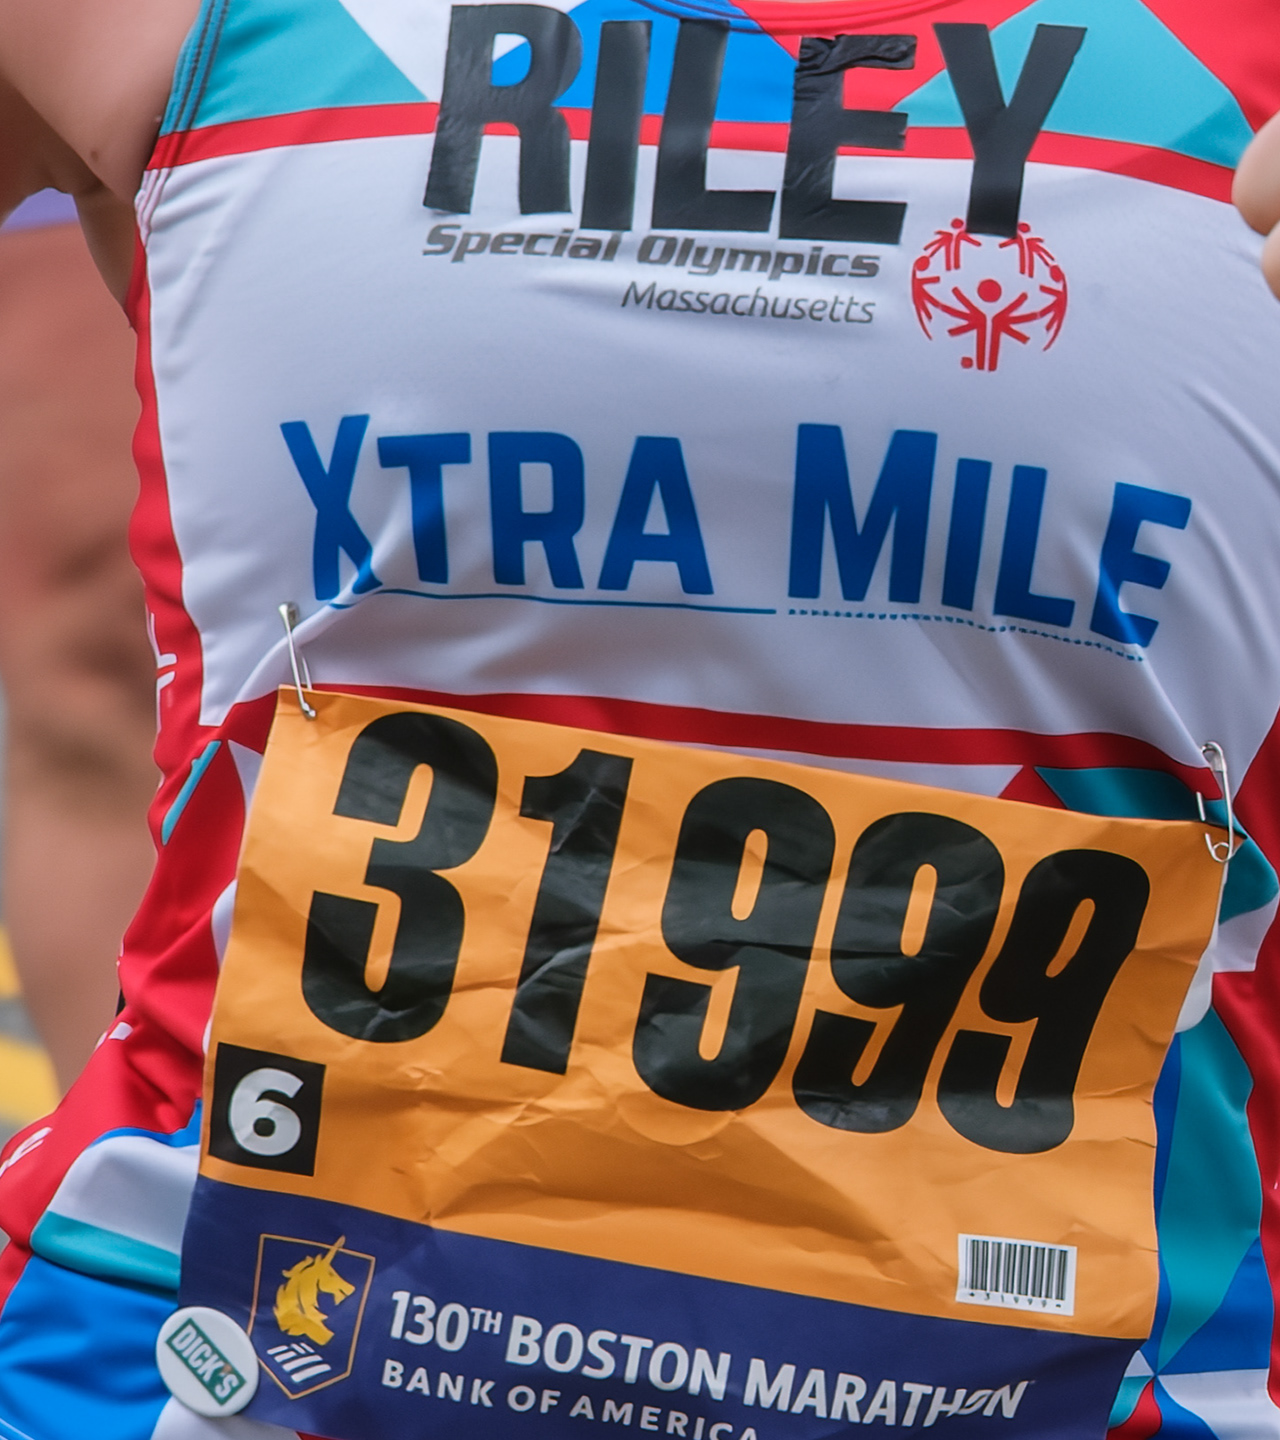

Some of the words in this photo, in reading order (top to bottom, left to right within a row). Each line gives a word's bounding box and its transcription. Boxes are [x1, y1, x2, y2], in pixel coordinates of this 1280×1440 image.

[423, 2, 1088, 245] RILEY
[422, 223, 623, 263] Special
[636, 233, 881, 281] Olympics
[621, 281, 876, 324] Massachusetts
[279, 413, 715, 602] XTRA
[788, 422, 1194, 649] MILE
[300, 710, 1152, 1155] 31999
[228, 1067, 304, 1156] 6
[171, 1324, 240, 1398] DICK'S
[381, 1359, 496, 1408] BANK
[508, 1385, 562, 1415] OF
[389, 1290, 502, 1352] 130TH
[505, 1315, 733, 1400] BOSTON
[743, 1358, 1030, 1428] MARATHON
